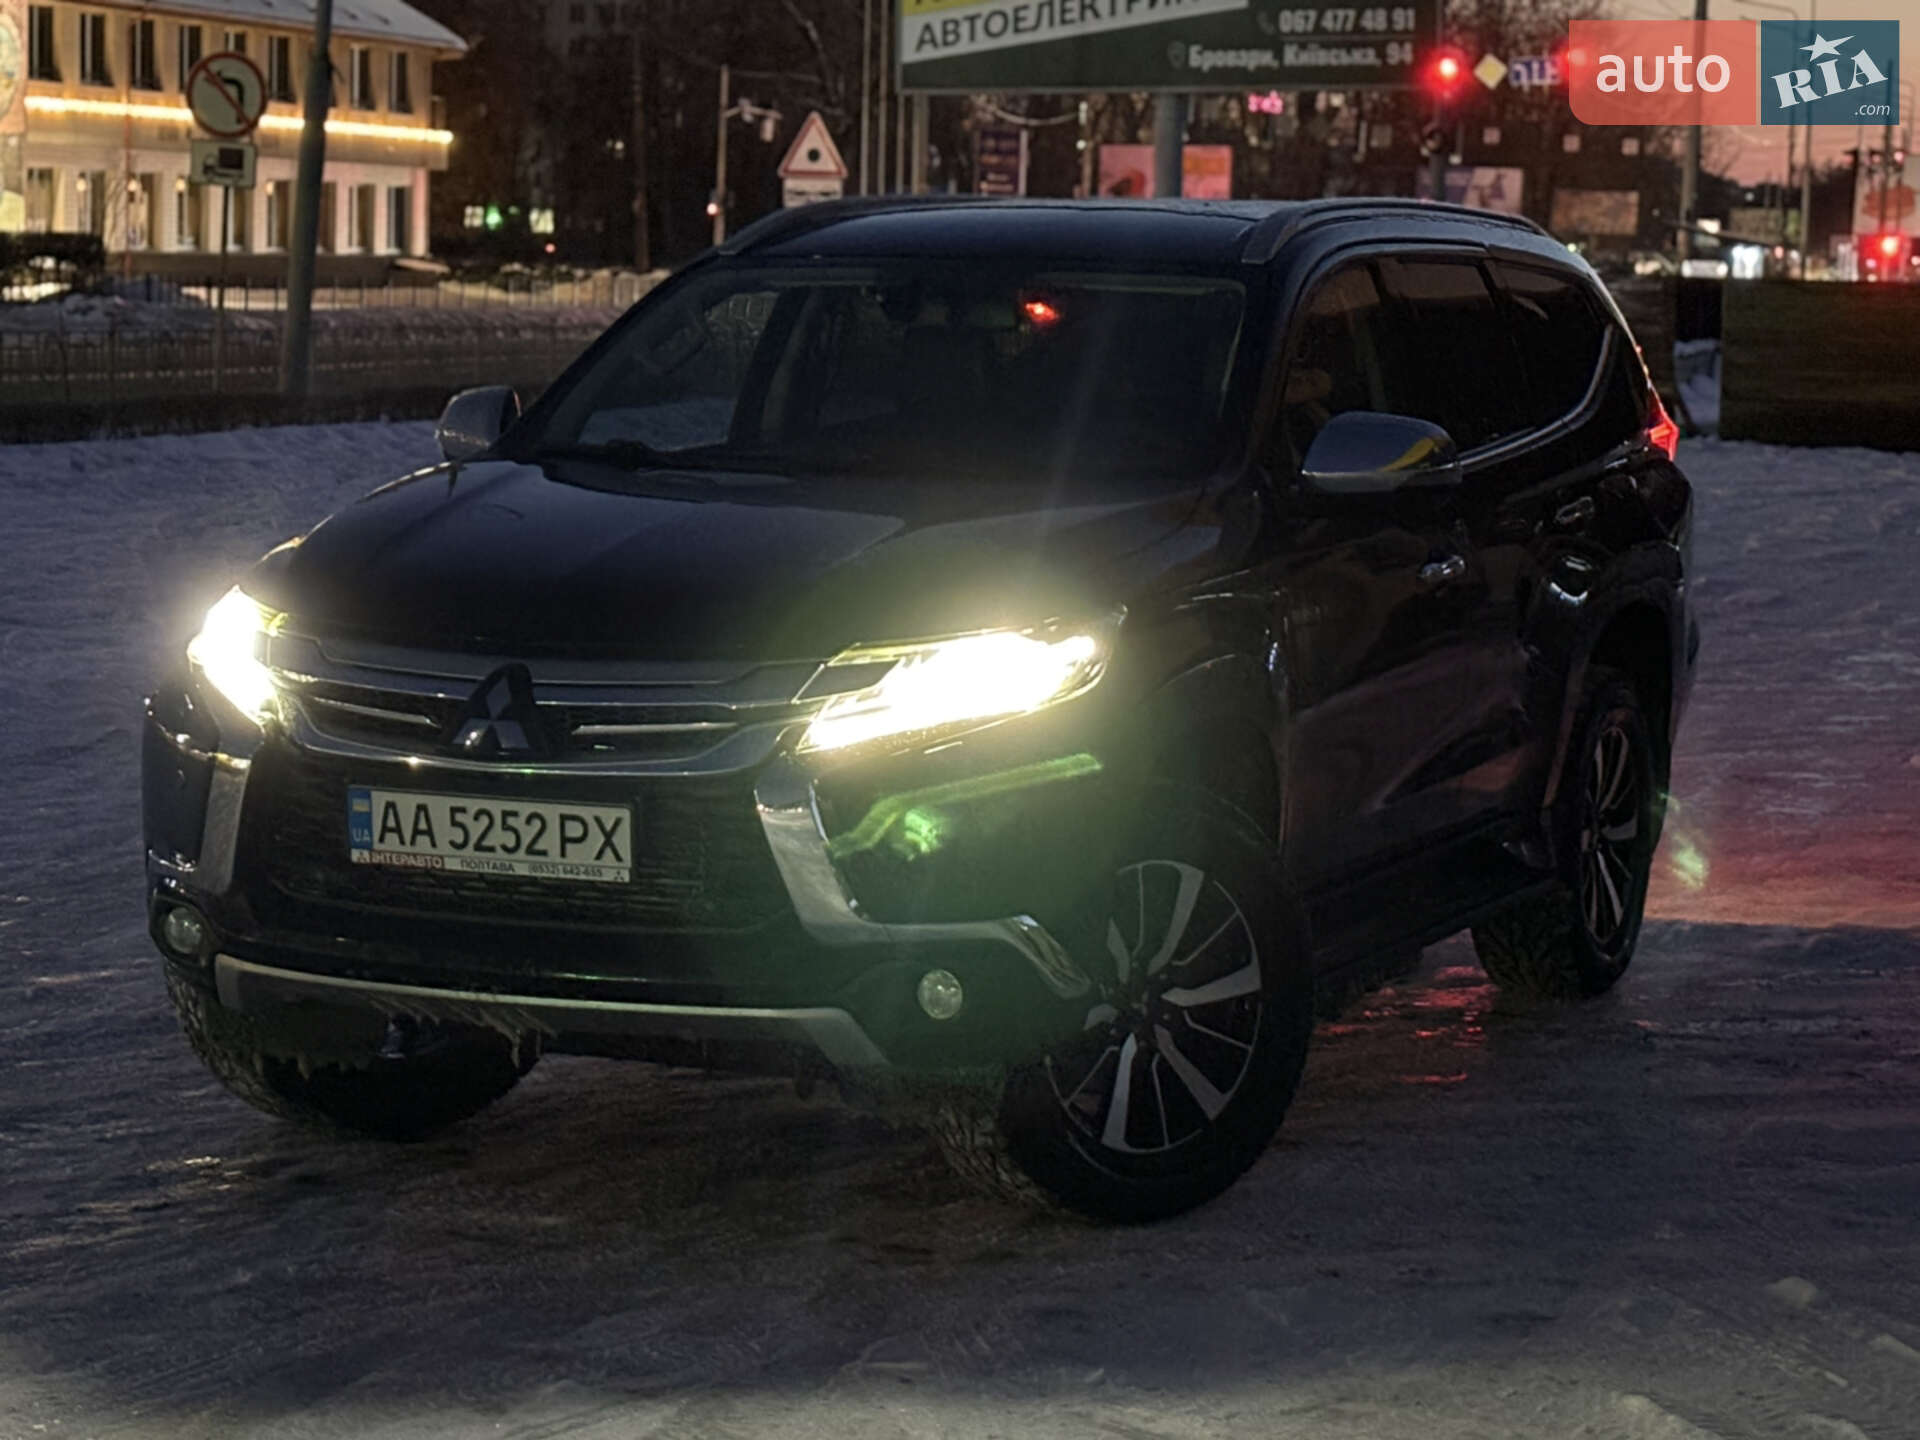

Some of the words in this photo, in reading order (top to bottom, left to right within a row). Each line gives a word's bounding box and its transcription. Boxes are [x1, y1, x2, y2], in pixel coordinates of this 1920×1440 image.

[915, 0, 1198, 53] АВТОЕЛЕКТР
[1321, 8, 1357, 32] 477
[1392, 7, 1416, 32] 91
[352, 828, 371, 843] UA
[448, 805, 548, 857] 5252
